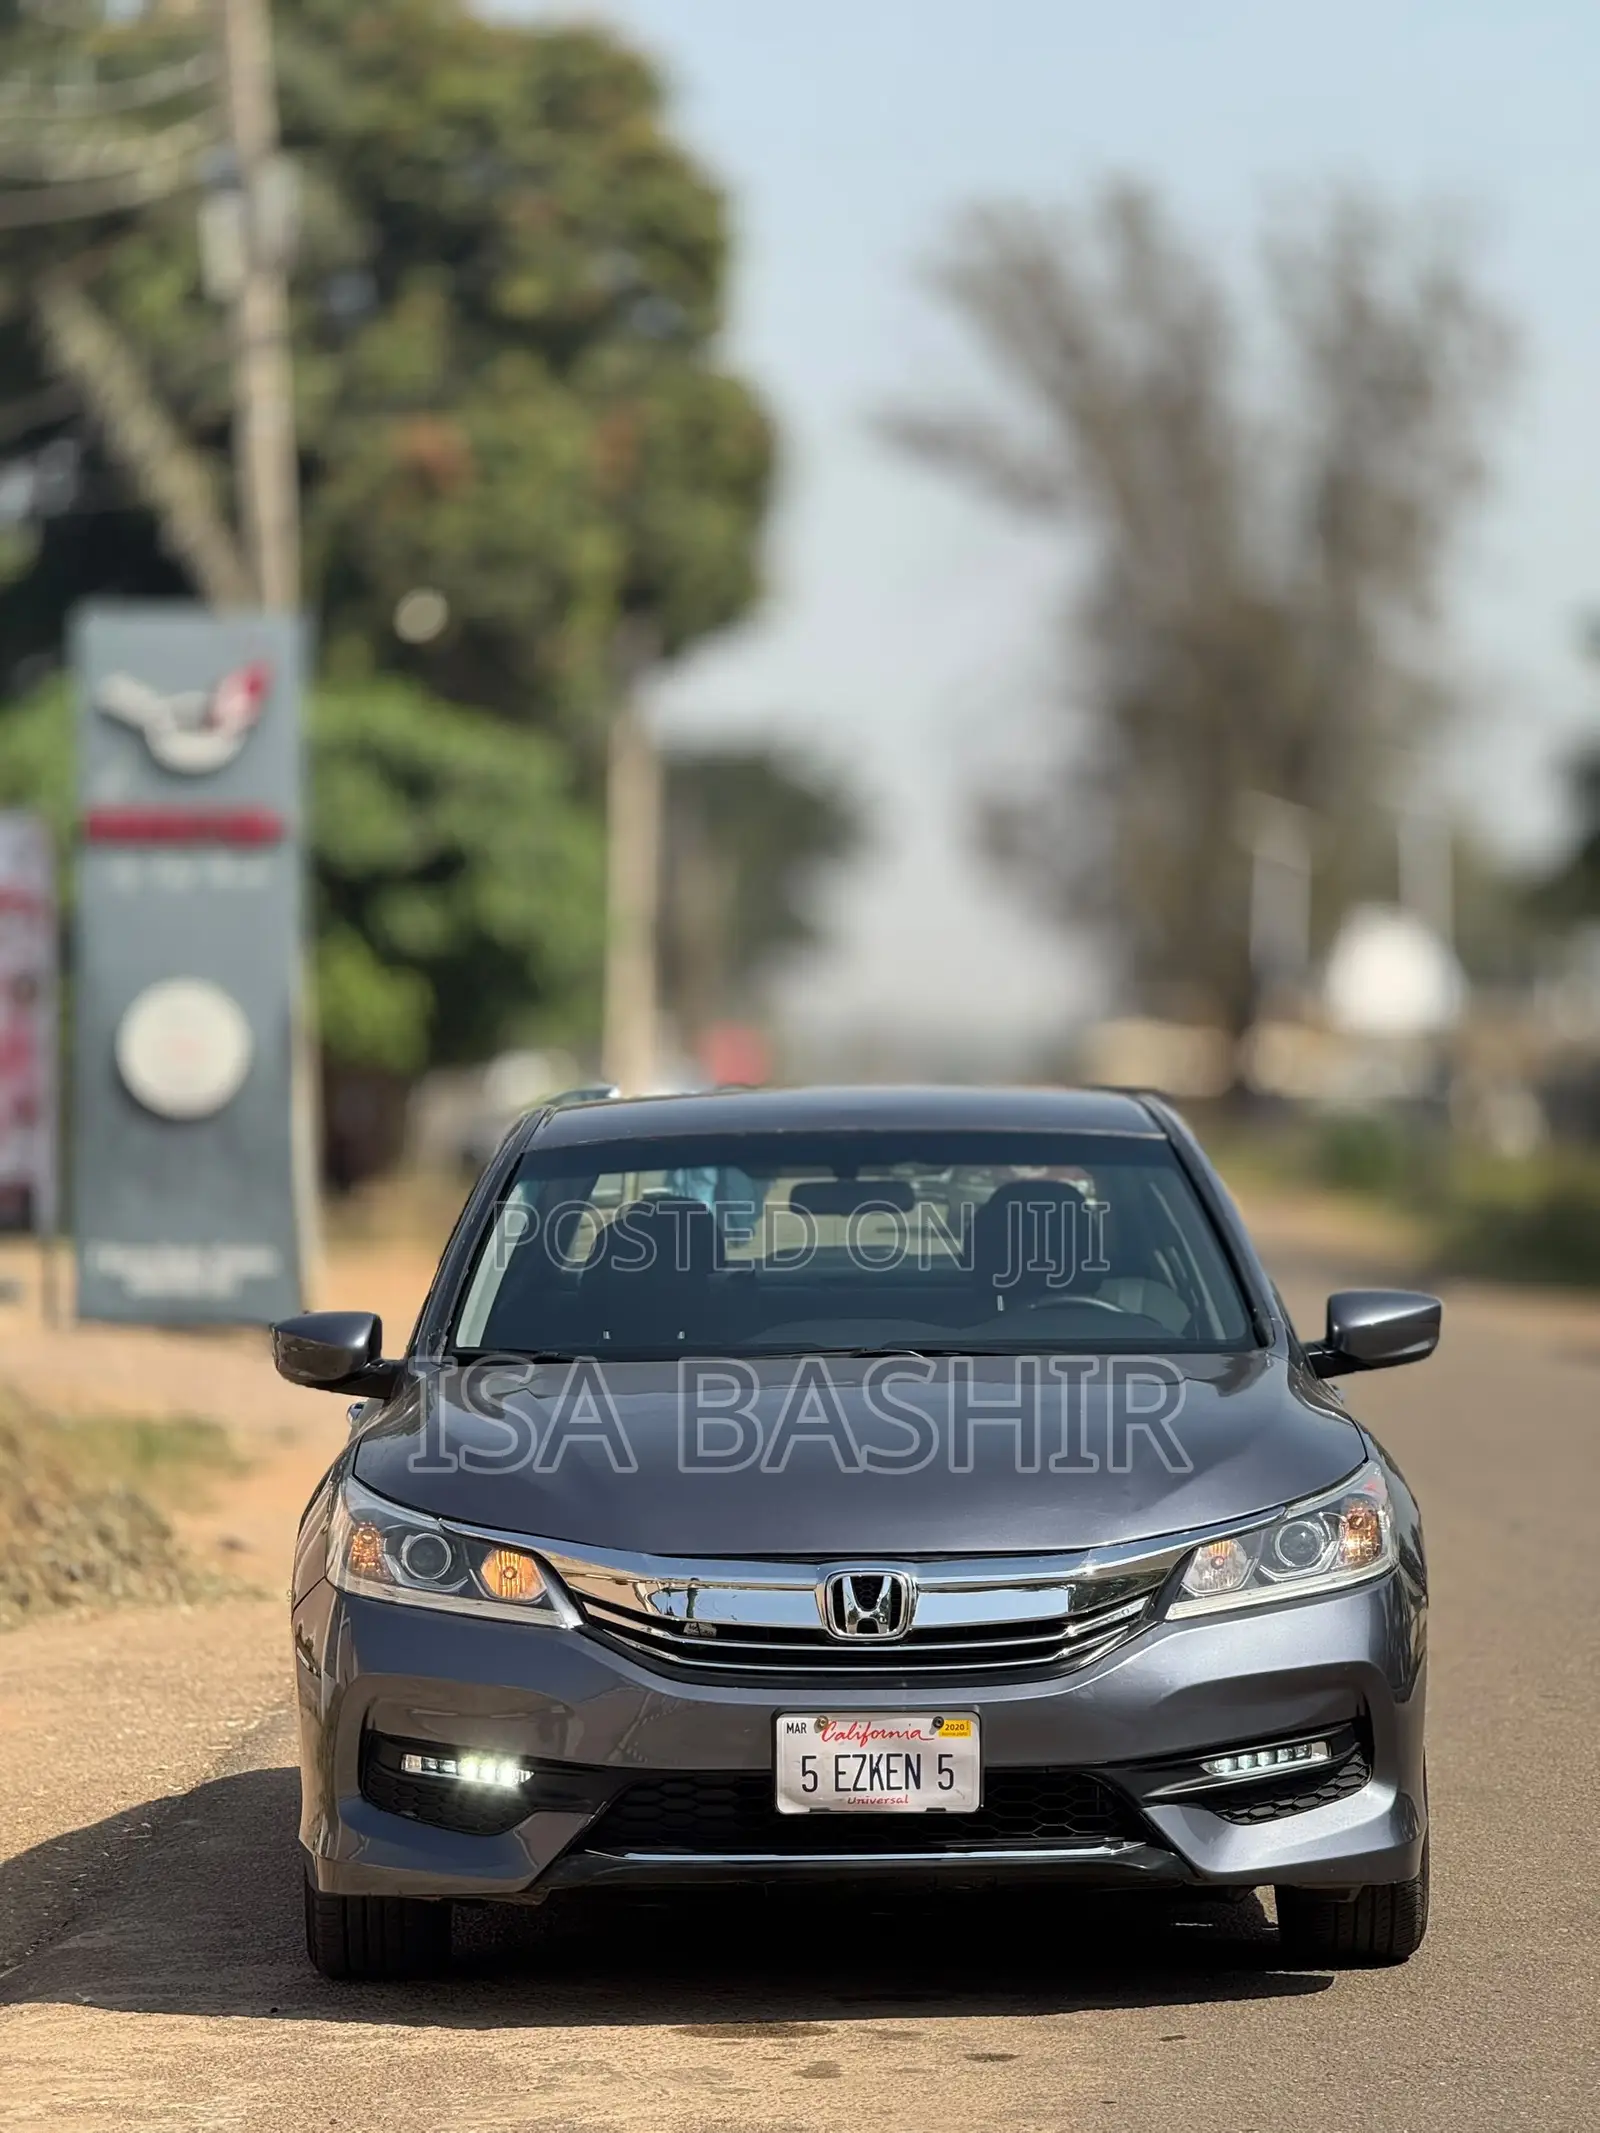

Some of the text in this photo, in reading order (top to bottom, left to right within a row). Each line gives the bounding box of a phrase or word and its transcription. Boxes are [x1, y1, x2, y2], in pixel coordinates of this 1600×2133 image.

[786, 1722, 807, 1734] MAR
[944, 1723, 965, 1731] 2020
[821, 1720, 934, 1747] California
[801, 1753, 954, 1793] 5 EZKEN 5
[847, 1794, 909, 1805] Universal
